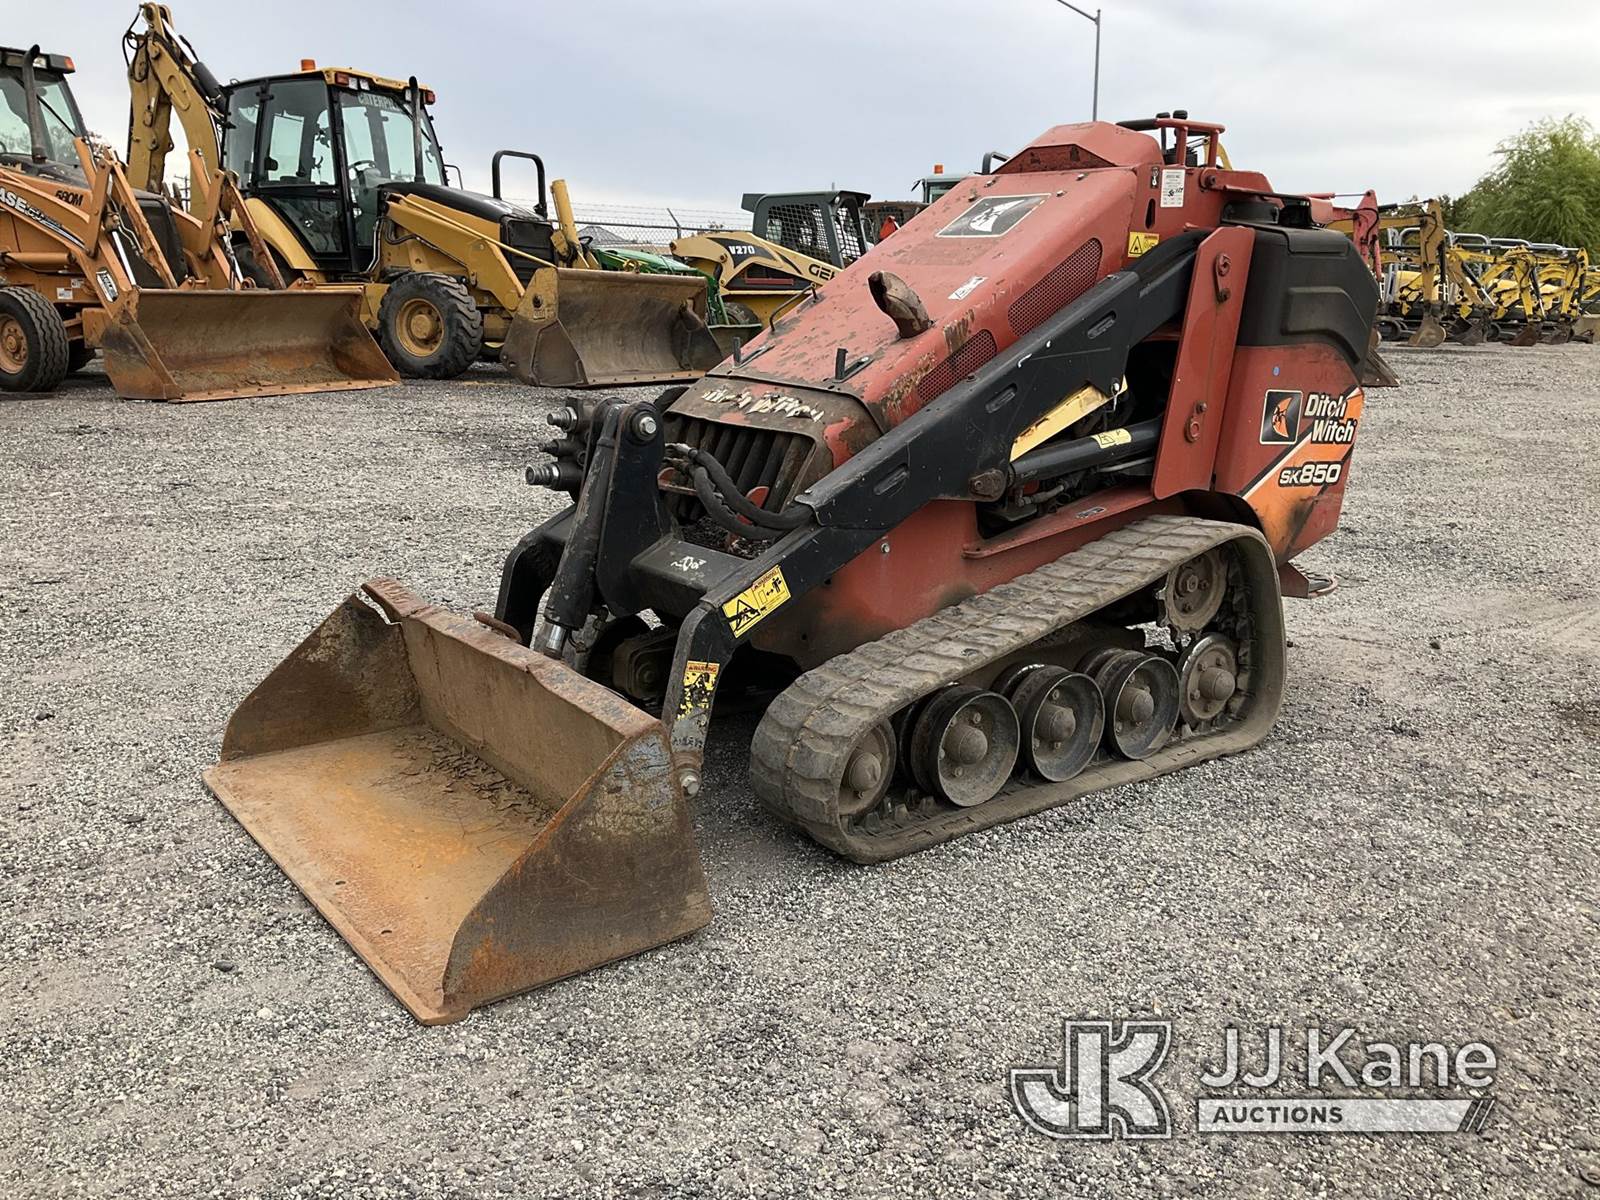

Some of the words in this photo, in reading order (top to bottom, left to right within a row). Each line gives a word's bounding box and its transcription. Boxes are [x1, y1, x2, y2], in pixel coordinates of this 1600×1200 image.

[728, 245, 756, 255] V270
[1303, 393, 1347, 418] Ditch
[1312, 419, 1355, 443] Witch
[1279, 463, 1342, 485] SK850
